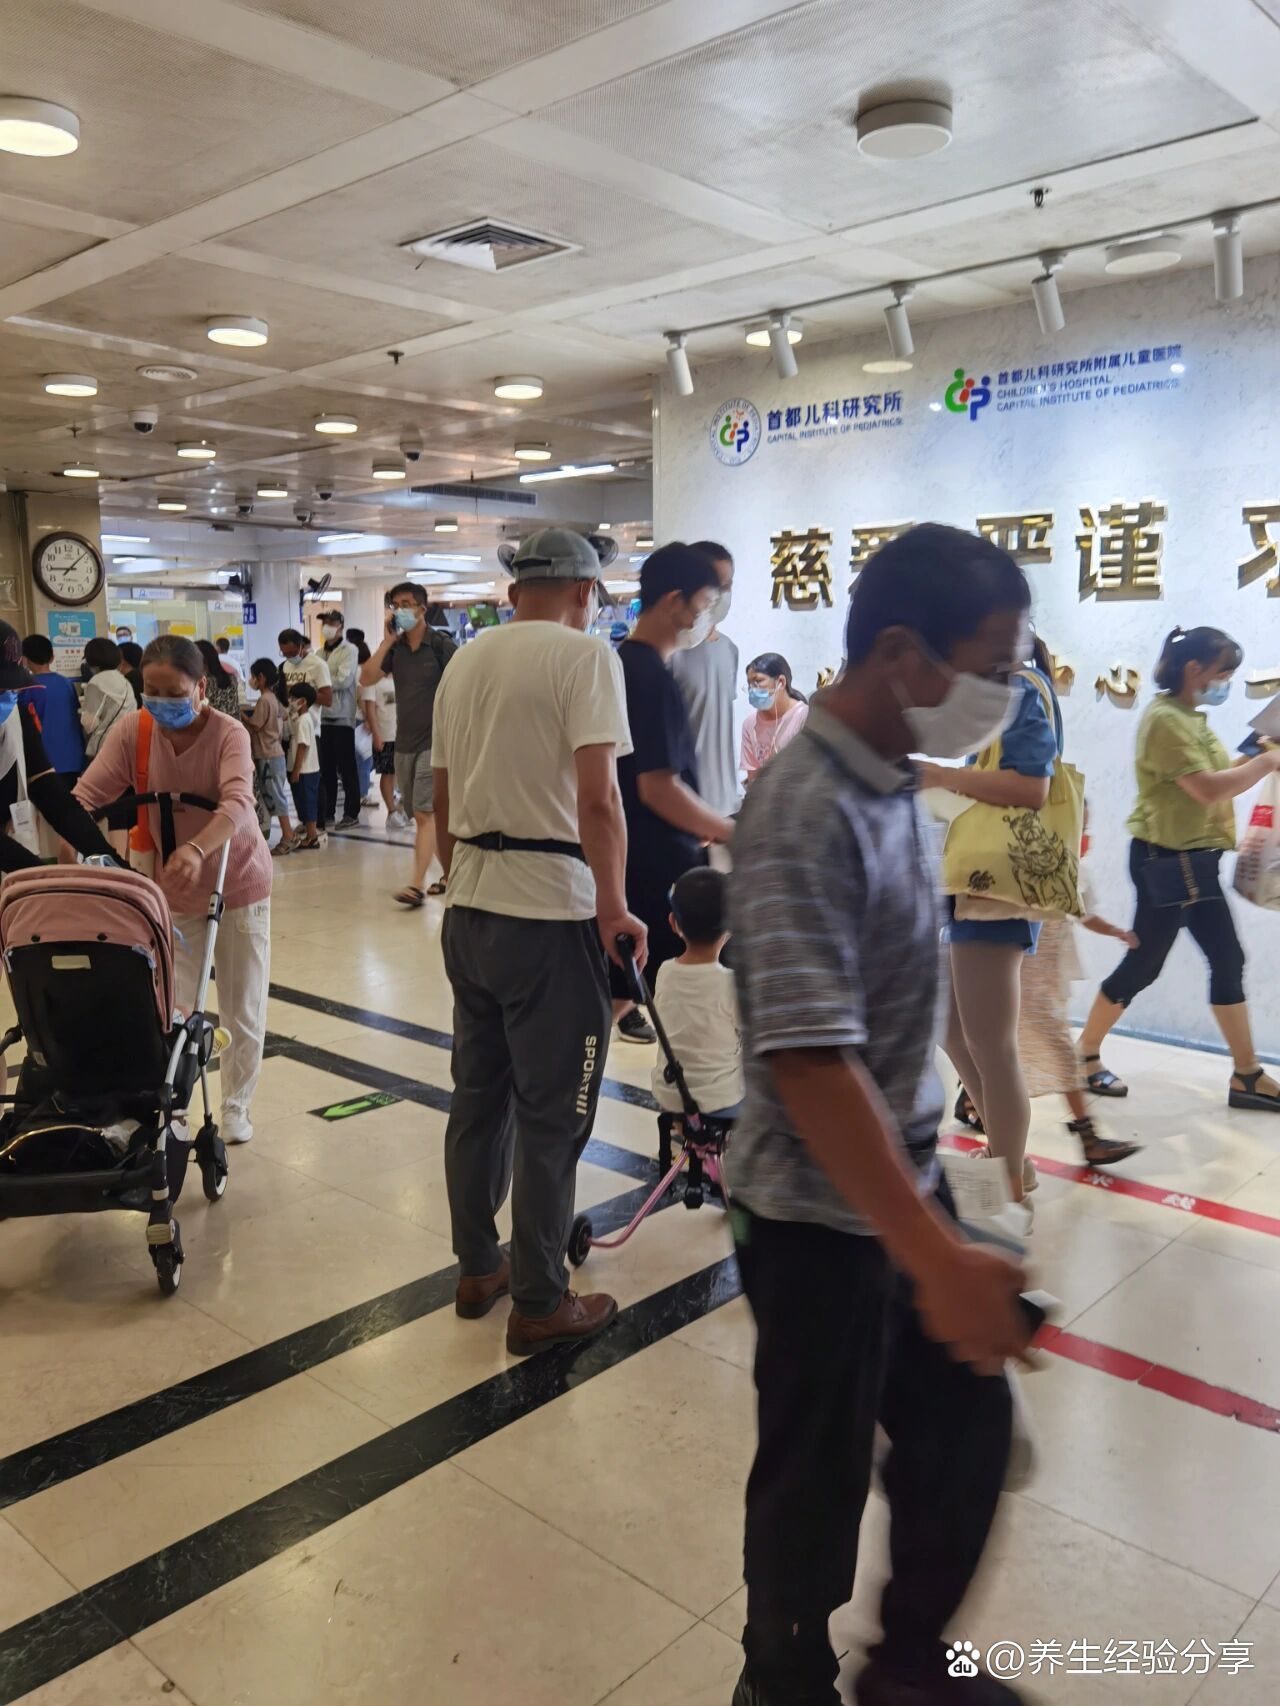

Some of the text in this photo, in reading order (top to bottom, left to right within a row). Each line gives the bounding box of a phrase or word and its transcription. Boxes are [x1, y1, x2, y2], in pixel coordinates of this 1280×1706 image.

[997, 344, 1182, 385] 首都儿科研究所附属儿童医院
[997, 378, 1180, 411] CAPITAL INSTITUTE OF PEDIATRICS
[1060, 374, 1111, 391] HOSPITAL
[767, 390, 902, 431] 首都儿科研究所
[767, 416, 903, 444] CAPITAL INSTITUTE OF PEDIATRICS
[285, 672, 306, 683] UCCI
